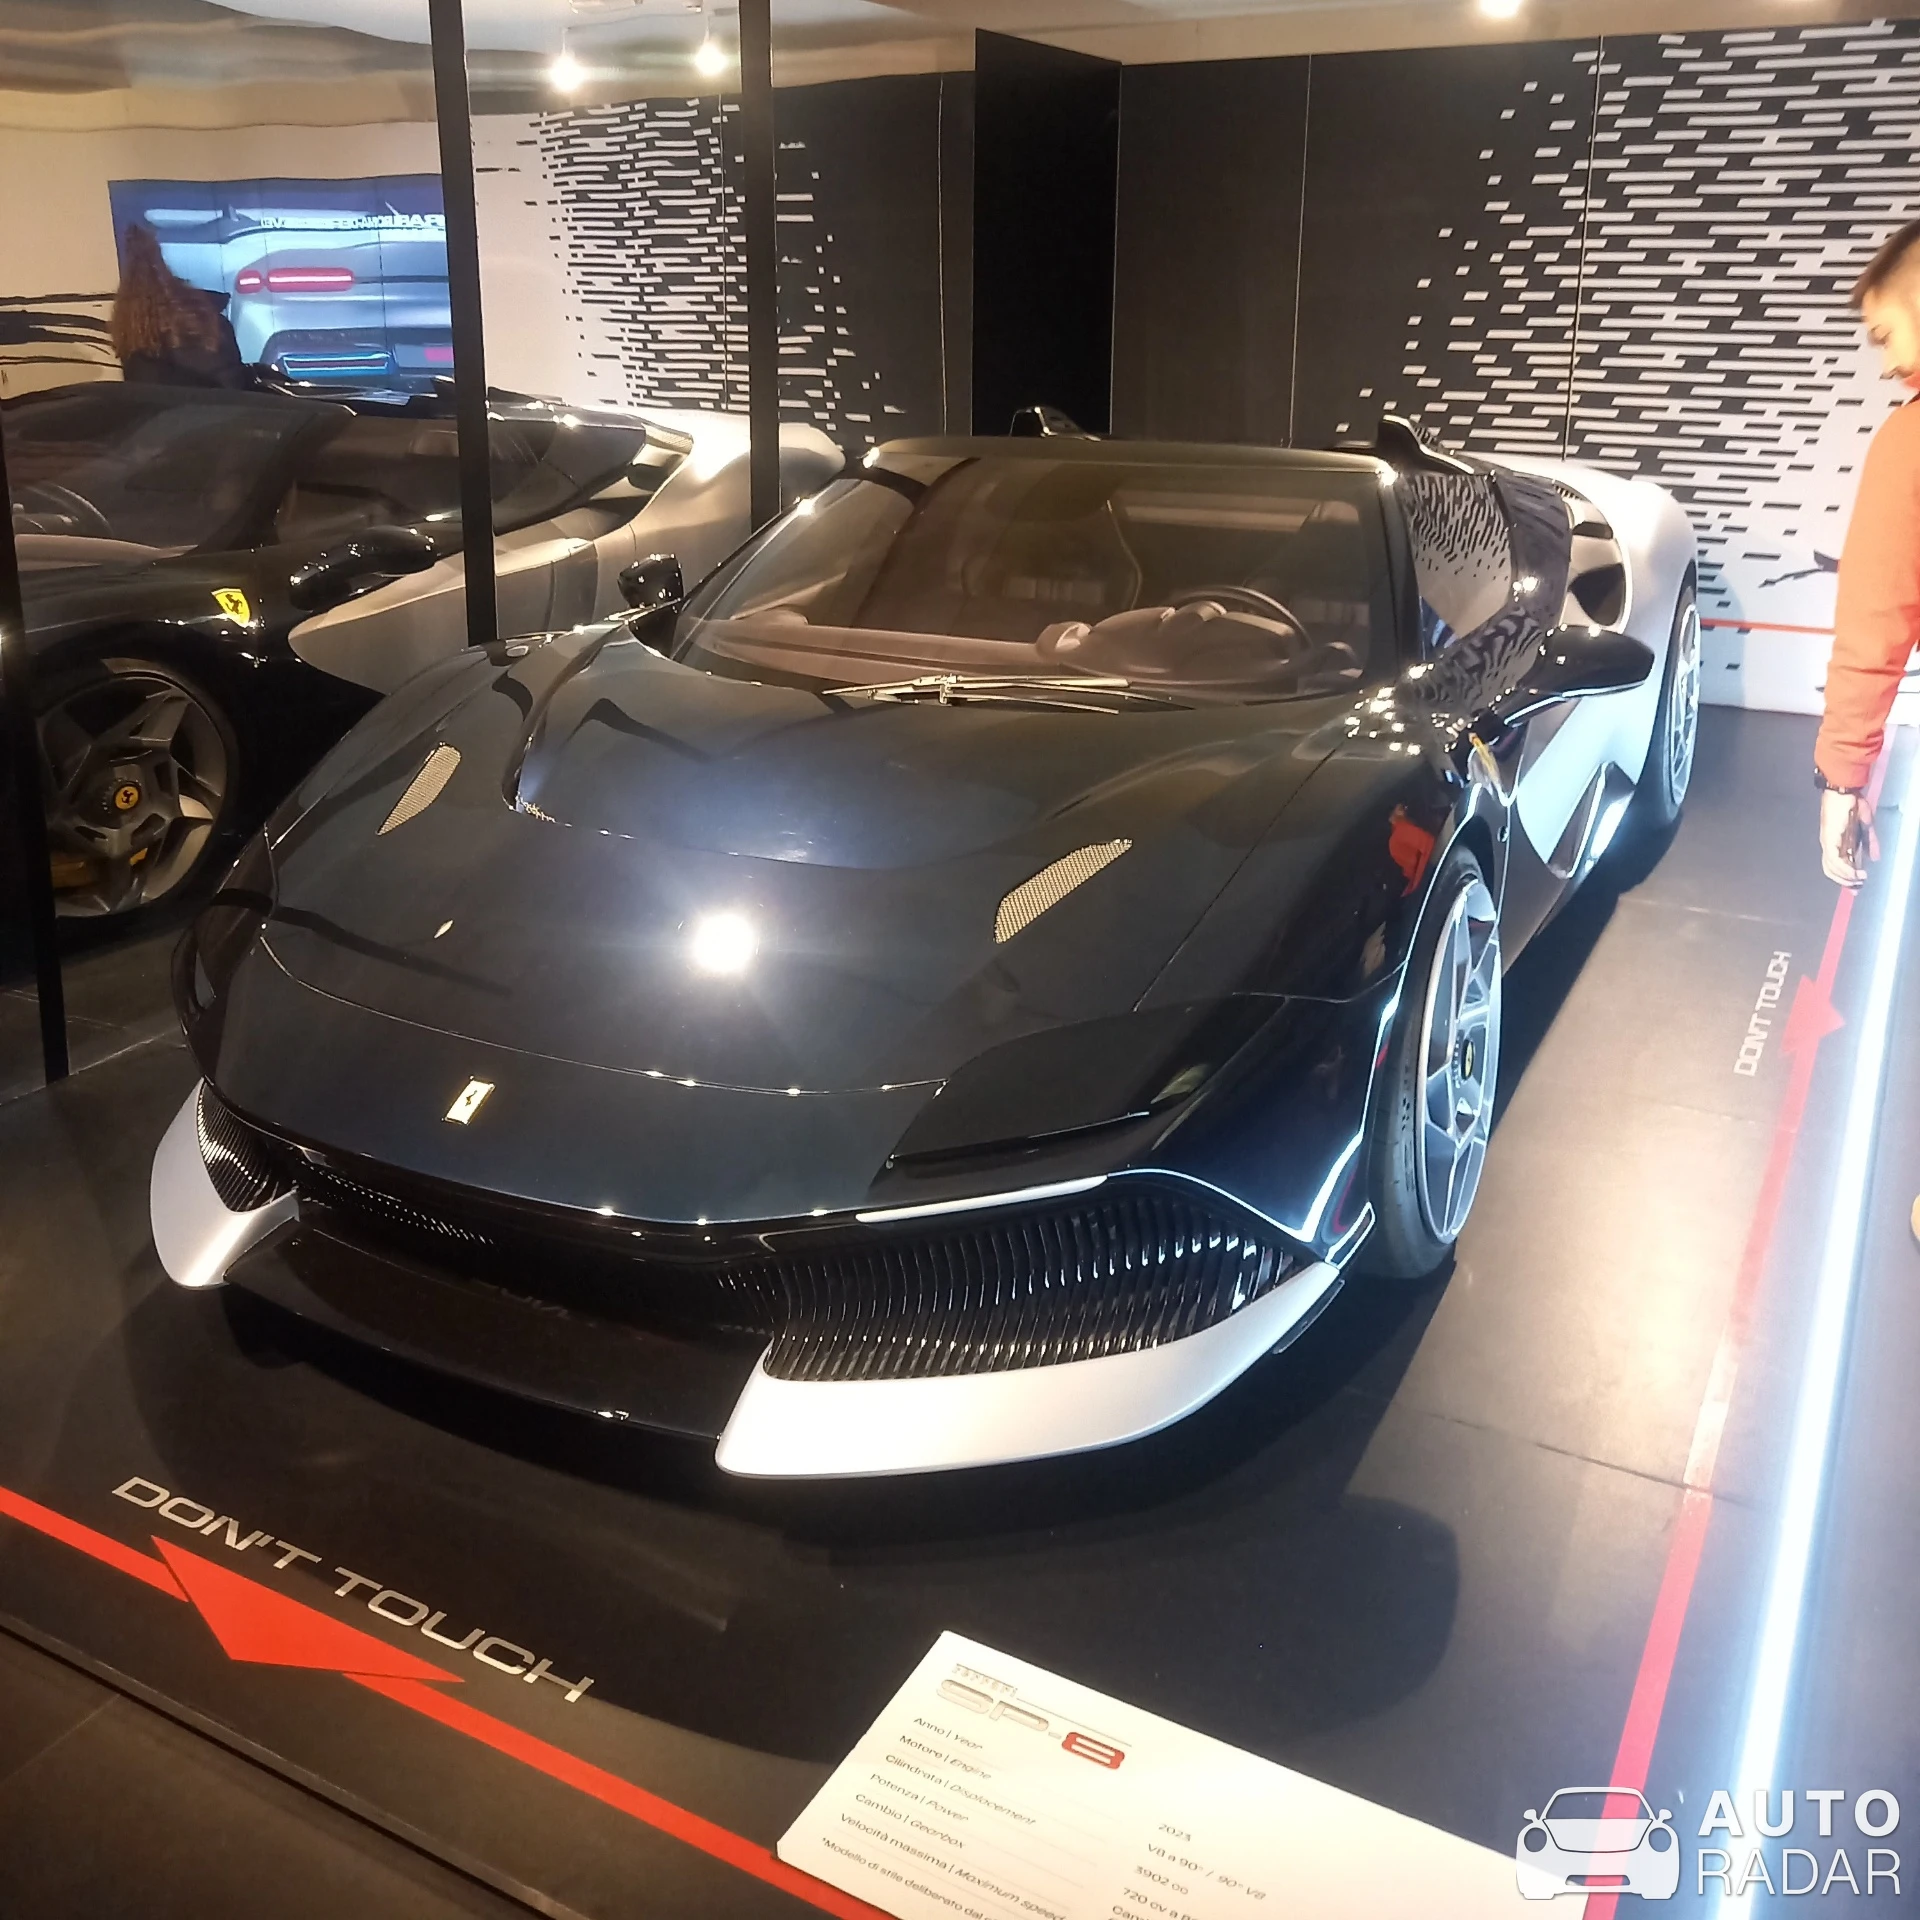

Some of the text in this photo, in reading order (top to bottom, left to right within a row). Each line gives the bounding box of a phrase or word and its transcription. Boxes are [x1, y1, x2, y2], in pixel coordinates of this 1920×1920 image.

[1755, 951, 1792, 1011] TOUCH
[112, 1476, 594, 1703] DON'T TOUCH
[900, 1735, 943, 1759] Motore
[950, 1758, 991, 1780] Engine
[914, 1717, 945, 1735] Anno
[954, 1734, 983, 1750] Year
[870, 1773, 919, 1801] Potenza
[926, 1800, 969, 1821] Power
[885, 1754, 943, 1785] Cilindrata
[950, 1784, 1036, 1825] Displacement
[855, 1794, 902, 1820] Cambio
[910, 1820, 966, 1849] Gearbox
[1158, 1823, 1191, 1842] 2023
[841, 1813, 888, 1842] Velocità
[890, 1837, 947, 1870] massima
[954, 1868, 1020, 1903] Maximum
[1134, 1865, 1170, 1886] 3902
[867, 1860, 880, 1872] di
[880, 1866, 904, 1883] stile
[904, 1879, 963, 1911] deliberato
[1122, 1887, 1148, 1904] 720
